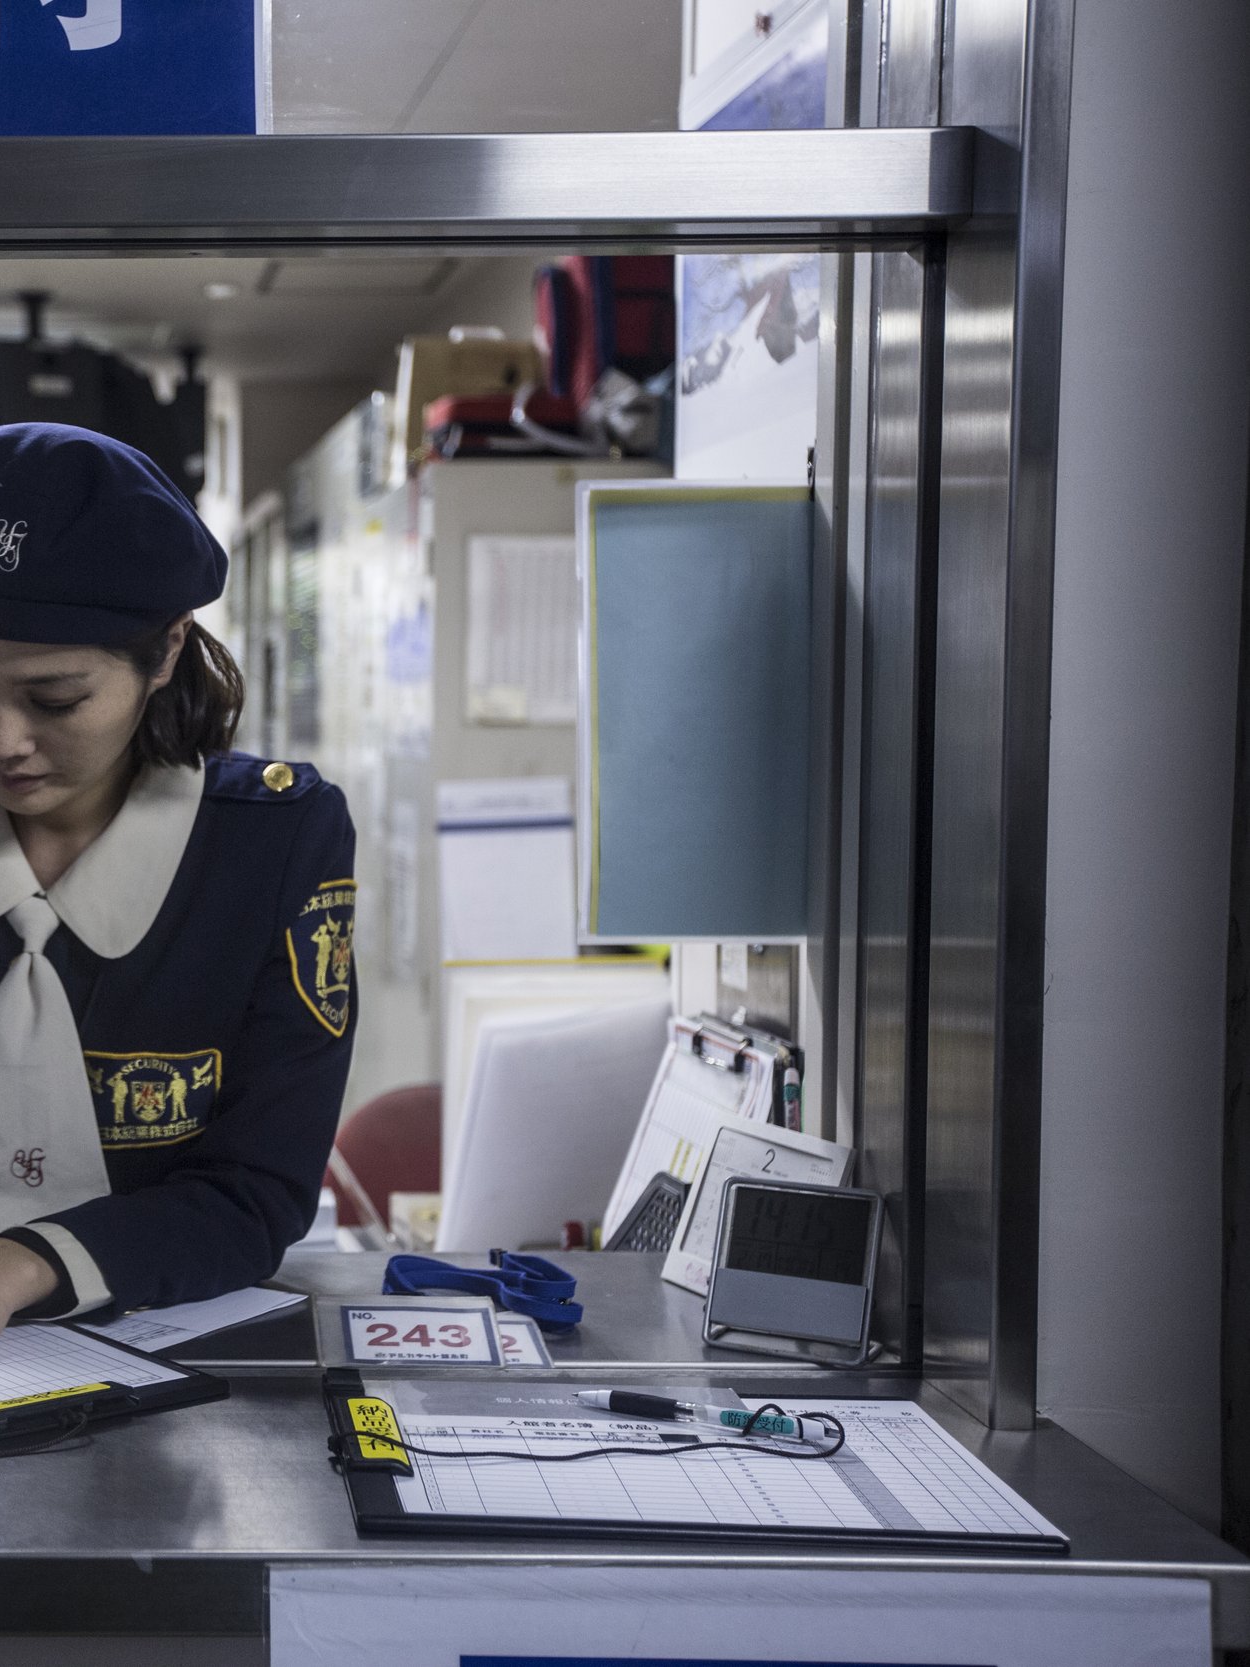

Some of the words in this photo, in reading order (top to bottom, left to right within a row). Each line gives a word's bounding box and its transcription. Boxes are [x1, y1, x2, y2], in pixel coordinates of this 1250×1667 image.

[120, 1058, 178, 1075] SECURITY
[762, 1148, 776, 1173] 2
[351, 1312, 376, 1320] NO.
[365, 1323, 472, 1348] 243
